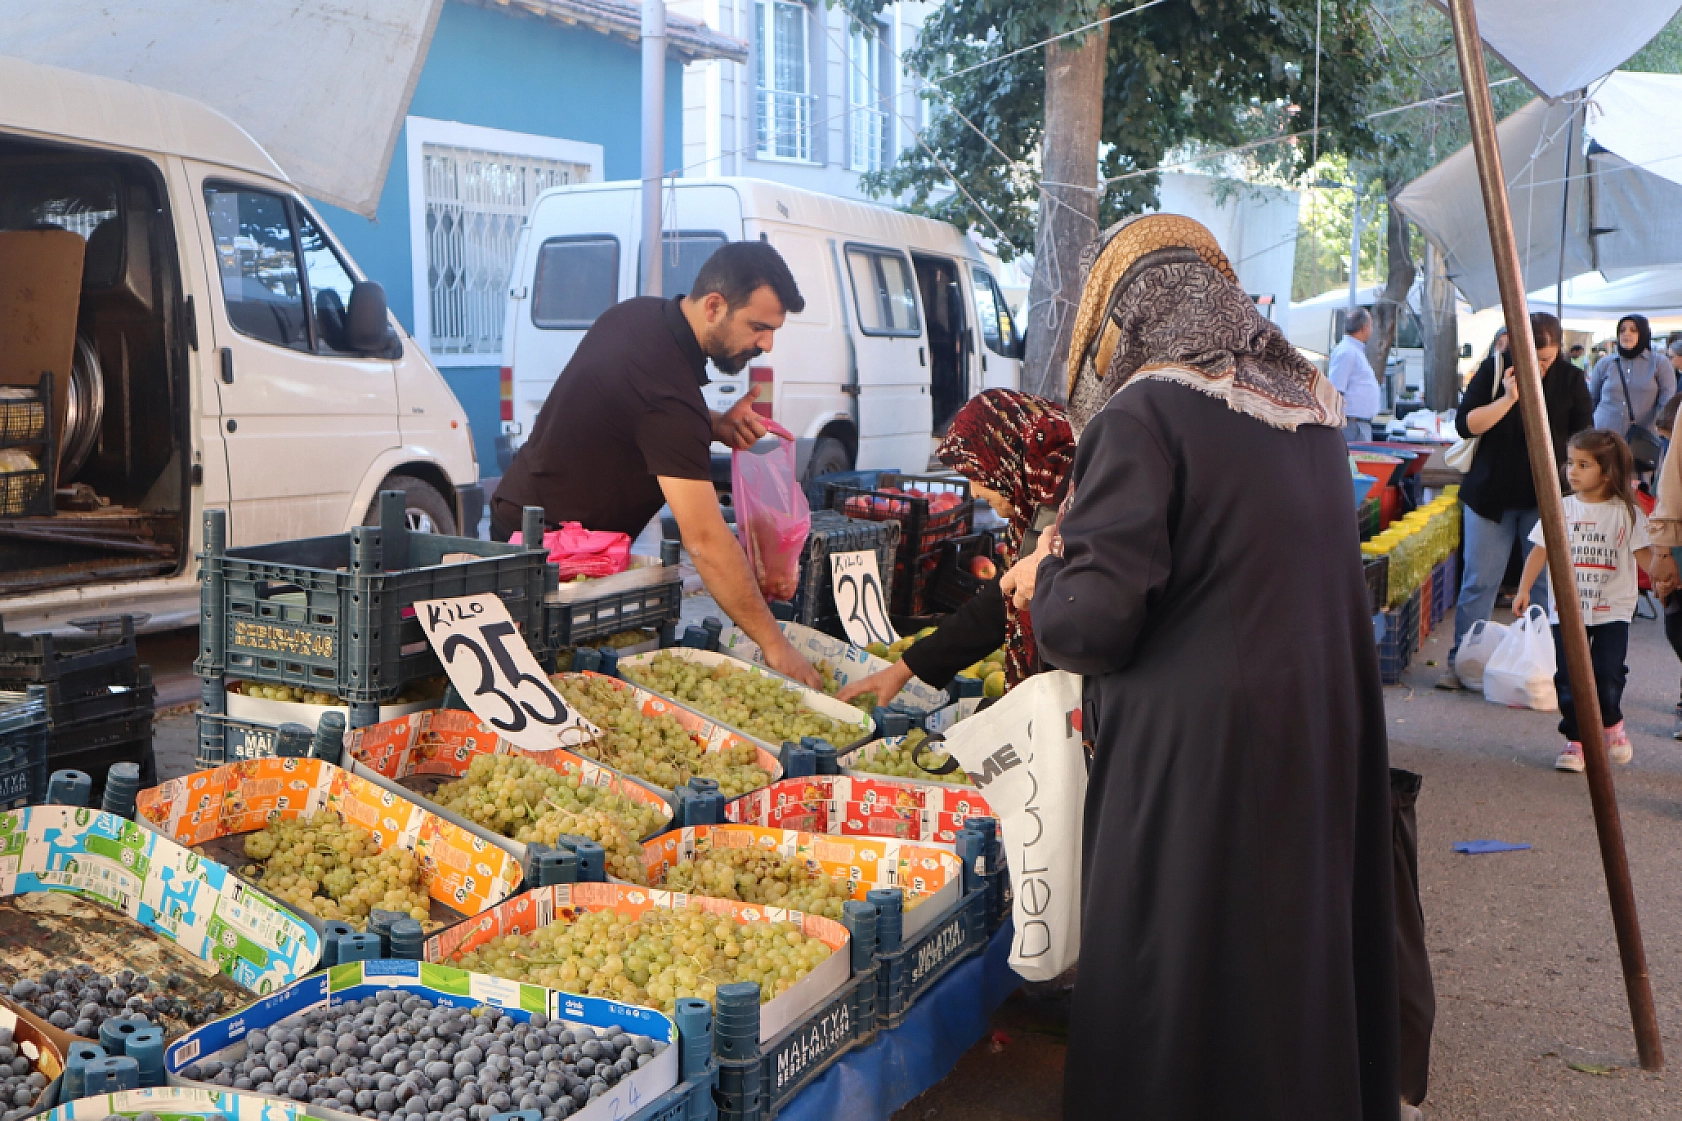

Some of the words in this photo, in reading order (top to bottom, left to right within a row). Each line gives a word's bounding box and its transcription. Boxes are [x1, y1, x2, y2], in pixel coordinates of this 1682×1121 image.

[838, 572, 895, 649] 30
[443, 620, 569, 733] 35
[777, 1003, 850, 1074] MALATYA
